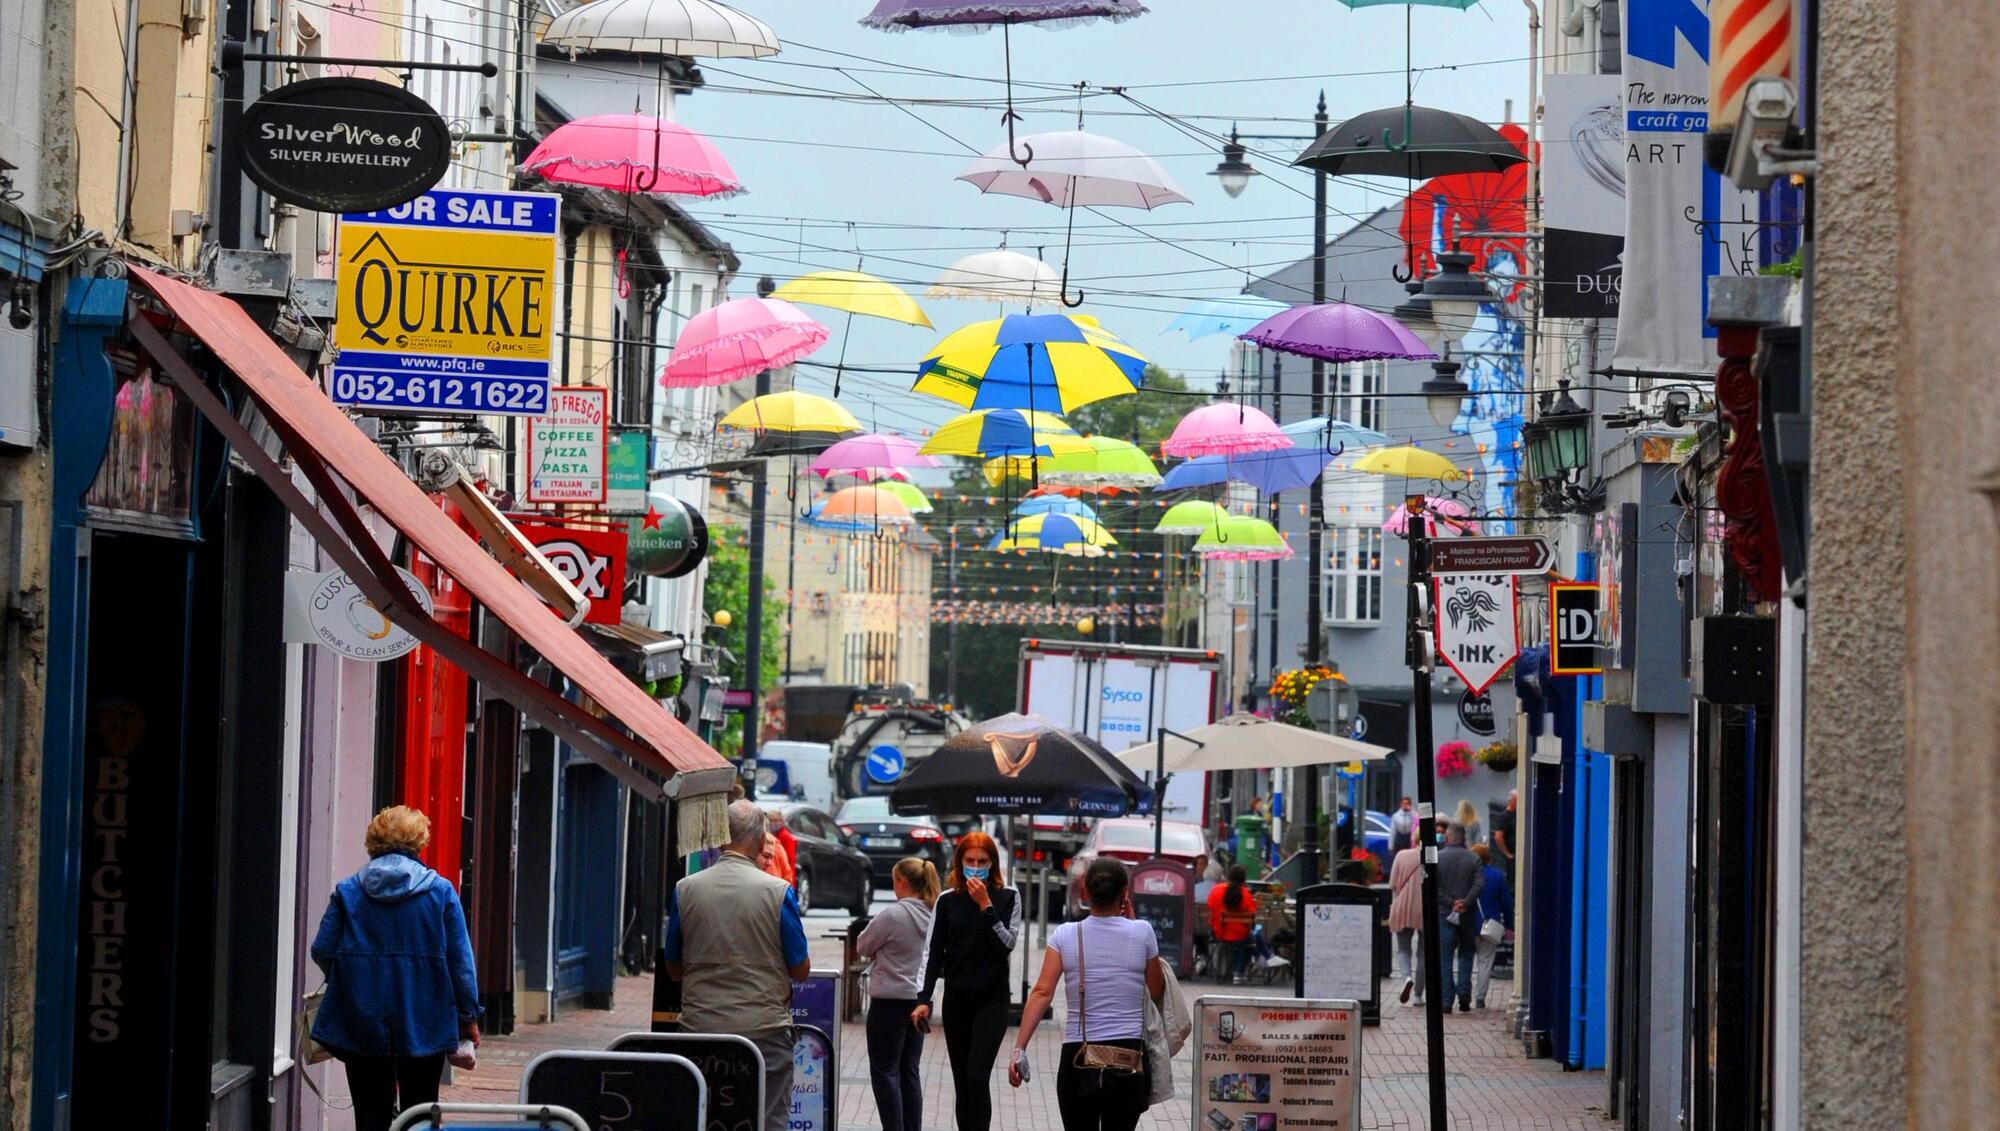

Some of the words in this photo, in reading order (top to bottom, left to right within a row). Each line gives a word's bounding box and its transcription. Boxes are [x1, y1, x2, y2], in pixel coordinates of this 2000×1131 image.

[1628, 82, 1656, 105] The
[1637, 113, 1679, 127] craft
[1683, 115, 1709, 132] ga
[269, 148, 322, 162] SILVER
[325, 151, 412, 168] JEWELLERY
[1626, 144, 1686, 164] ART
[447, 197, 534, 227] SALE
[354, 257, 545, 346] QUIRKE
[502, 343, 523, 351] RICS
[401, 357, 485, 372] www.pfq.ie
[337, 373, 463, 406] 052-612
[470, 381, 544, 409] 1622
[562, 395, 601, 425] FRESCO
[537, 431, 594, 441] COFFEE
[544, 447, 587, 457] PIZZA
[542, 463, 588, 473] PASTA
[540, 489, 593, 497] RESTAURANT
[628, 537, 683, 550] eineken
[1454, 557, 1502, 566] FRANCISCAN
[1503, 556, 1530, 564] FRIARY
[320, 626, 344, 649] REPAIR
[355, 646, 386, 656] CLEAN
[1458, 643, 1496, 664] INK
[1103, 687, 1143, 703] Sysco
[1078, 801, 1120, 811] GUINNESS
[88, 756, 131, 1043] BUTCHERS
[1261, 1012, 1300, 1021] PHONE
[1303, 1012, 1347, 1021] REPAIR
[1302, 1033, 1346, 1041] SERVICES
[1235, 1054, 1307, 1064] PROFESSIONAL
[1308, 1056, 1349, 1065] REPAIRS
[1307, 1067, 1343, 1076] COMPUTER
